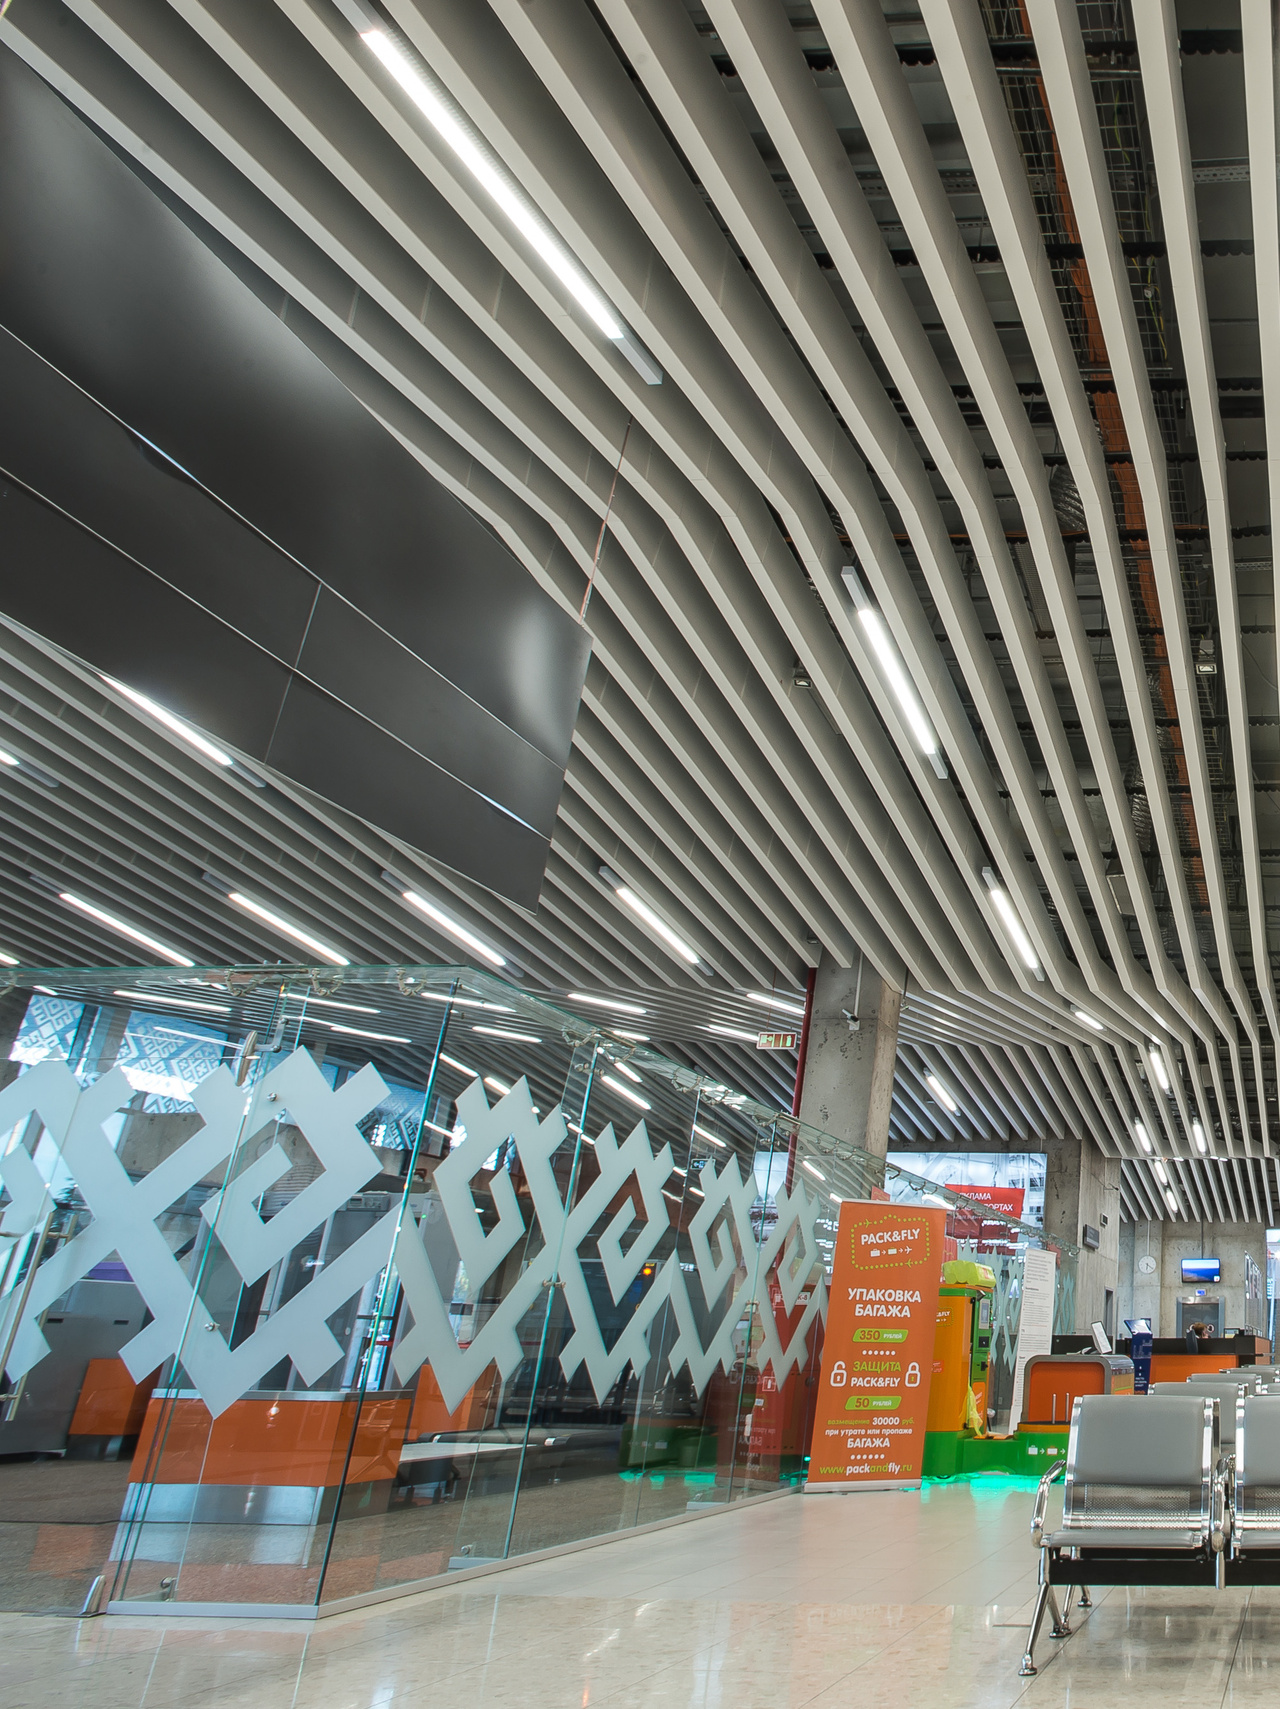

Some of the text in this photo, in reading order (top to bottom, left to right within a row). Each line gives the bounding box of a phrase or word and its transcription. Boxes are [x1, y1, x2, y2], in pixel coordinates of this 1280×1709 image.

[861, 1229, 920, 1245] PACK&FLY
[848, 1288, 921, 1303] УПАКОВКА
[855, 1304, 911, 1318] БАГАЖА
[860, 1330, 880, 1340] 350
[853, 1361, 901, 1373] ЗАЩИТА
[851, 1377, 900, 1387] PACK&FLY
[855, 1398, 869, 1408] 50
[872, 1417, 900, 1425] 30000
[902, 1417, 915, 1426] руб.
[847, 1438, 890, 1448] БАГАЖА
[820, 1463, 912, 1475] www.packandfly.ru
